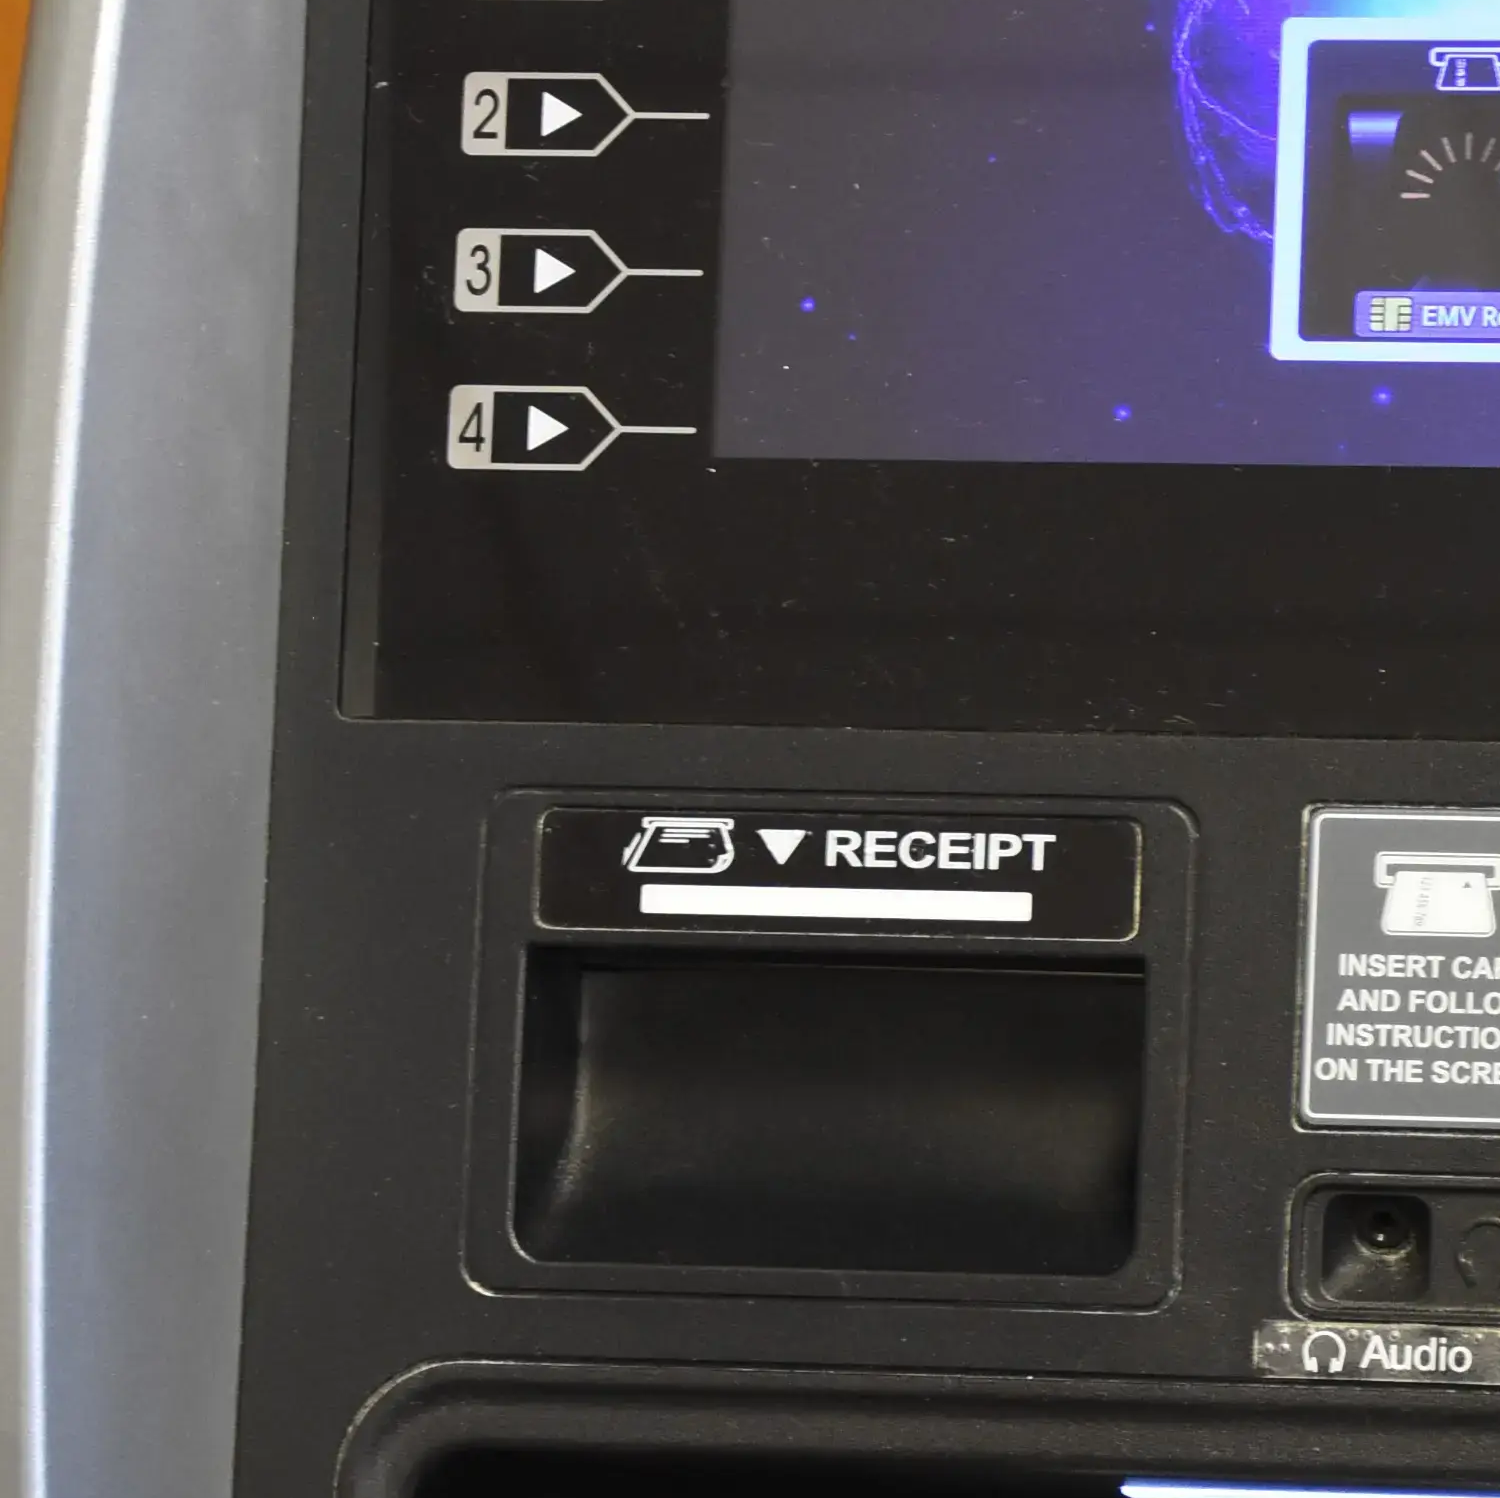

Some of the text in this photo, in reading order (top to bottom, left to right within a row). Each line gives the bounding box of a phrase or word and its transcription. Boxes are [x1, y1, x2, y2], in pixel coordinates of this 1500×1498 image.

[472, 88, 500, 139] 2
[466, 244, 492, 296] 3
[1421, 305, 1476, 327] EMV
[458, 402, 486, 453] 4
[825, 829, 1057, 872] RECEIPT
[1338, 953, 1444, 980] INSERT
[1336, 988, 1402, 1013] AND
[1314, 1057, 1358, 1083] ON
[1365, 1059, 1423, 1084] THE
[1359, 1334, 1473, 1373] Audio
